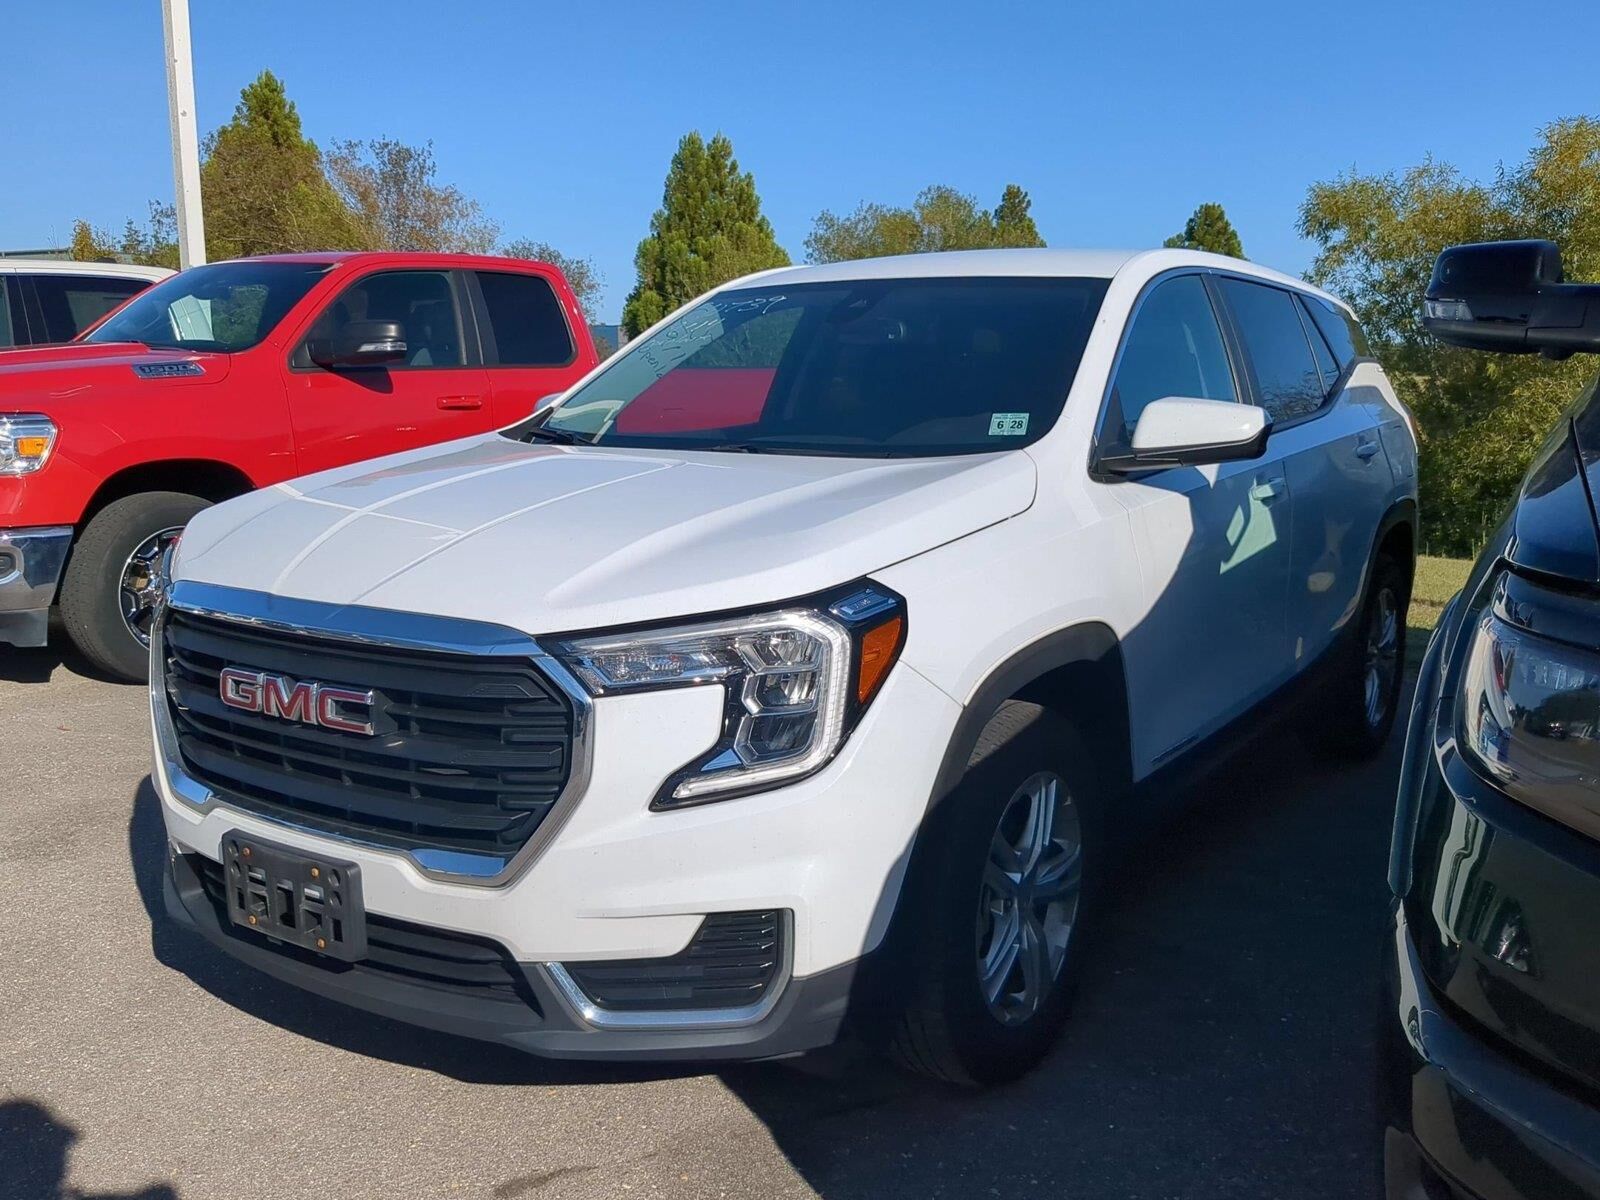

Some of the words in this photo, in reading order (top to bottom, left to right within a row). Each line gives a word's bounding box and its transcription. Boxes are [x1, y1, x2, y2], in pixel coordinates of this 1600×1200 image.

[997, 420, 1005, 430] 6
[1010, 420, 1024, 429] 28
[220, 667, 374, 736] GMC
